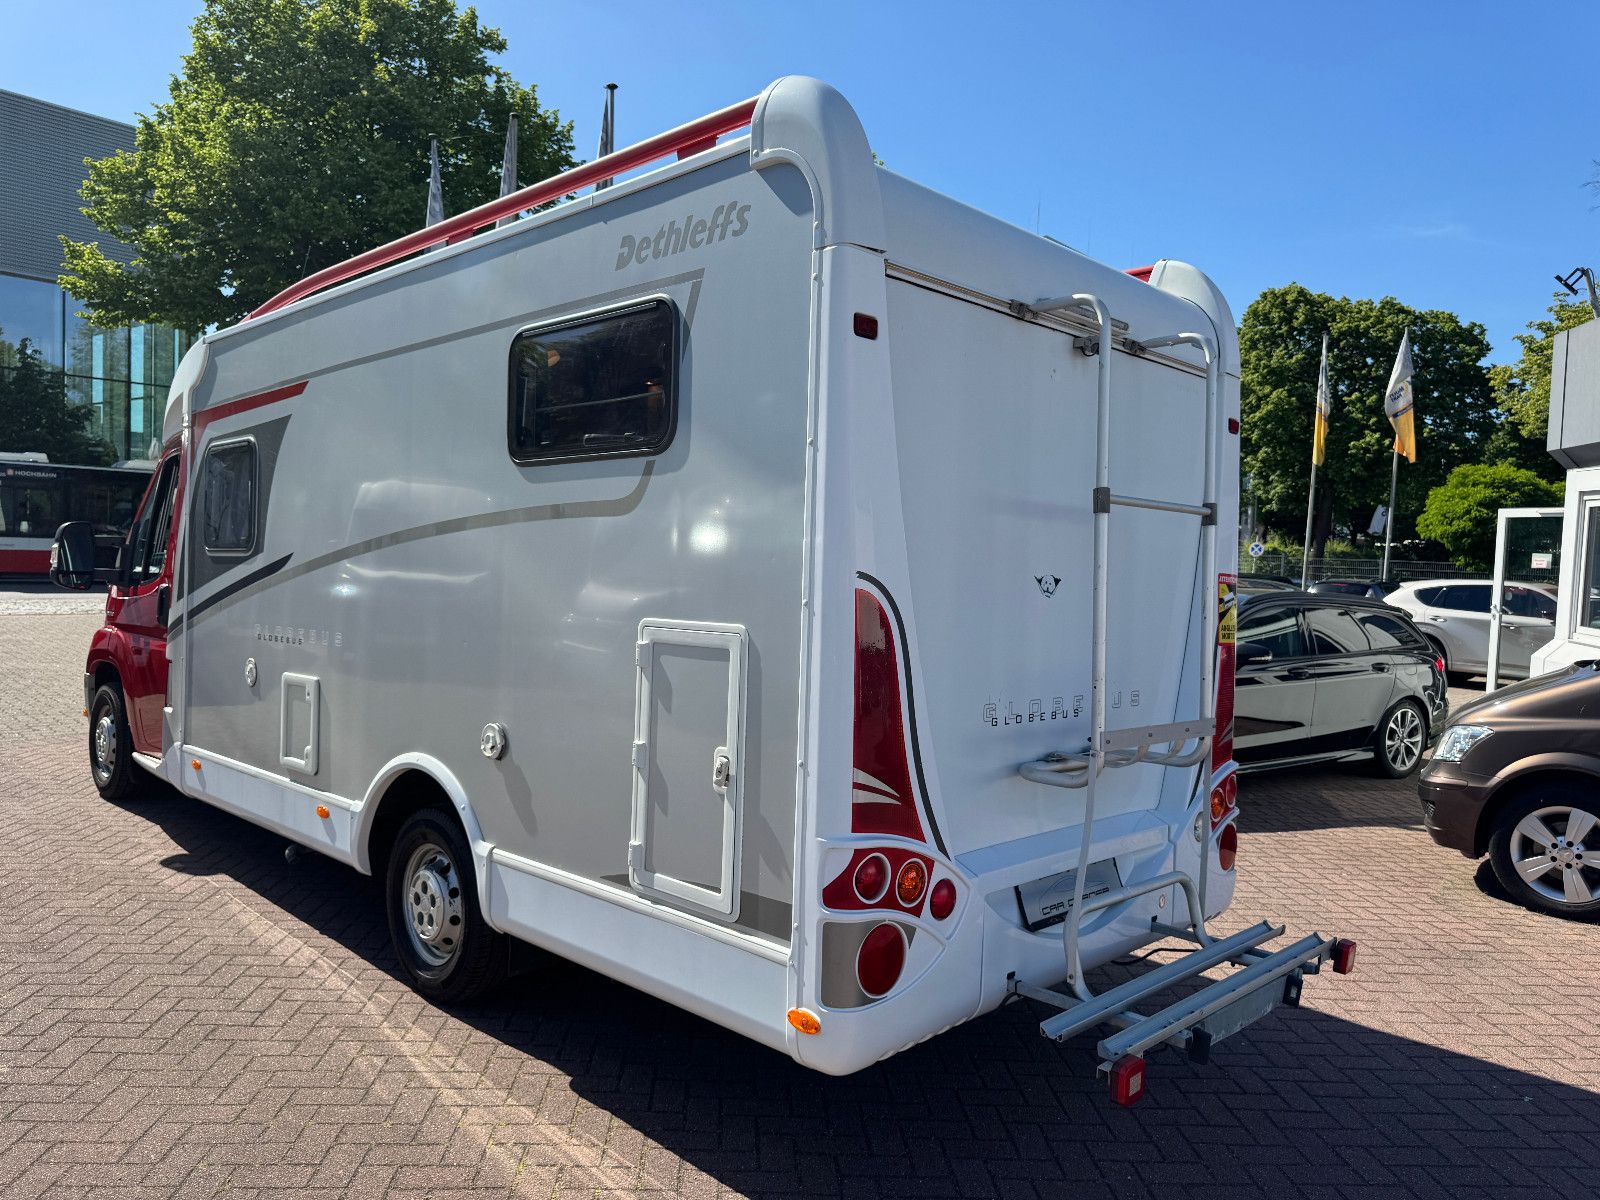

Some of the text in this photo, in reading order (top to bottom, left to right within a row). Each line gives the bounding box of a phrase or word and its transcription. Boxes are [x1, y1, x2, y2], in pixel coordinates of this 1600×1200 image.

[615, 201, 751, 271] Dethleffs
[15, 470, 57, 478] HOCHBAHN
[257, 633, 303, 645] GLOBEBUS
[983, 690, 1140, 722] GLOBEUS
[991, 709, 1079, 726] GLOBEBUS
[1041, 901, 1065, 915] CAR
